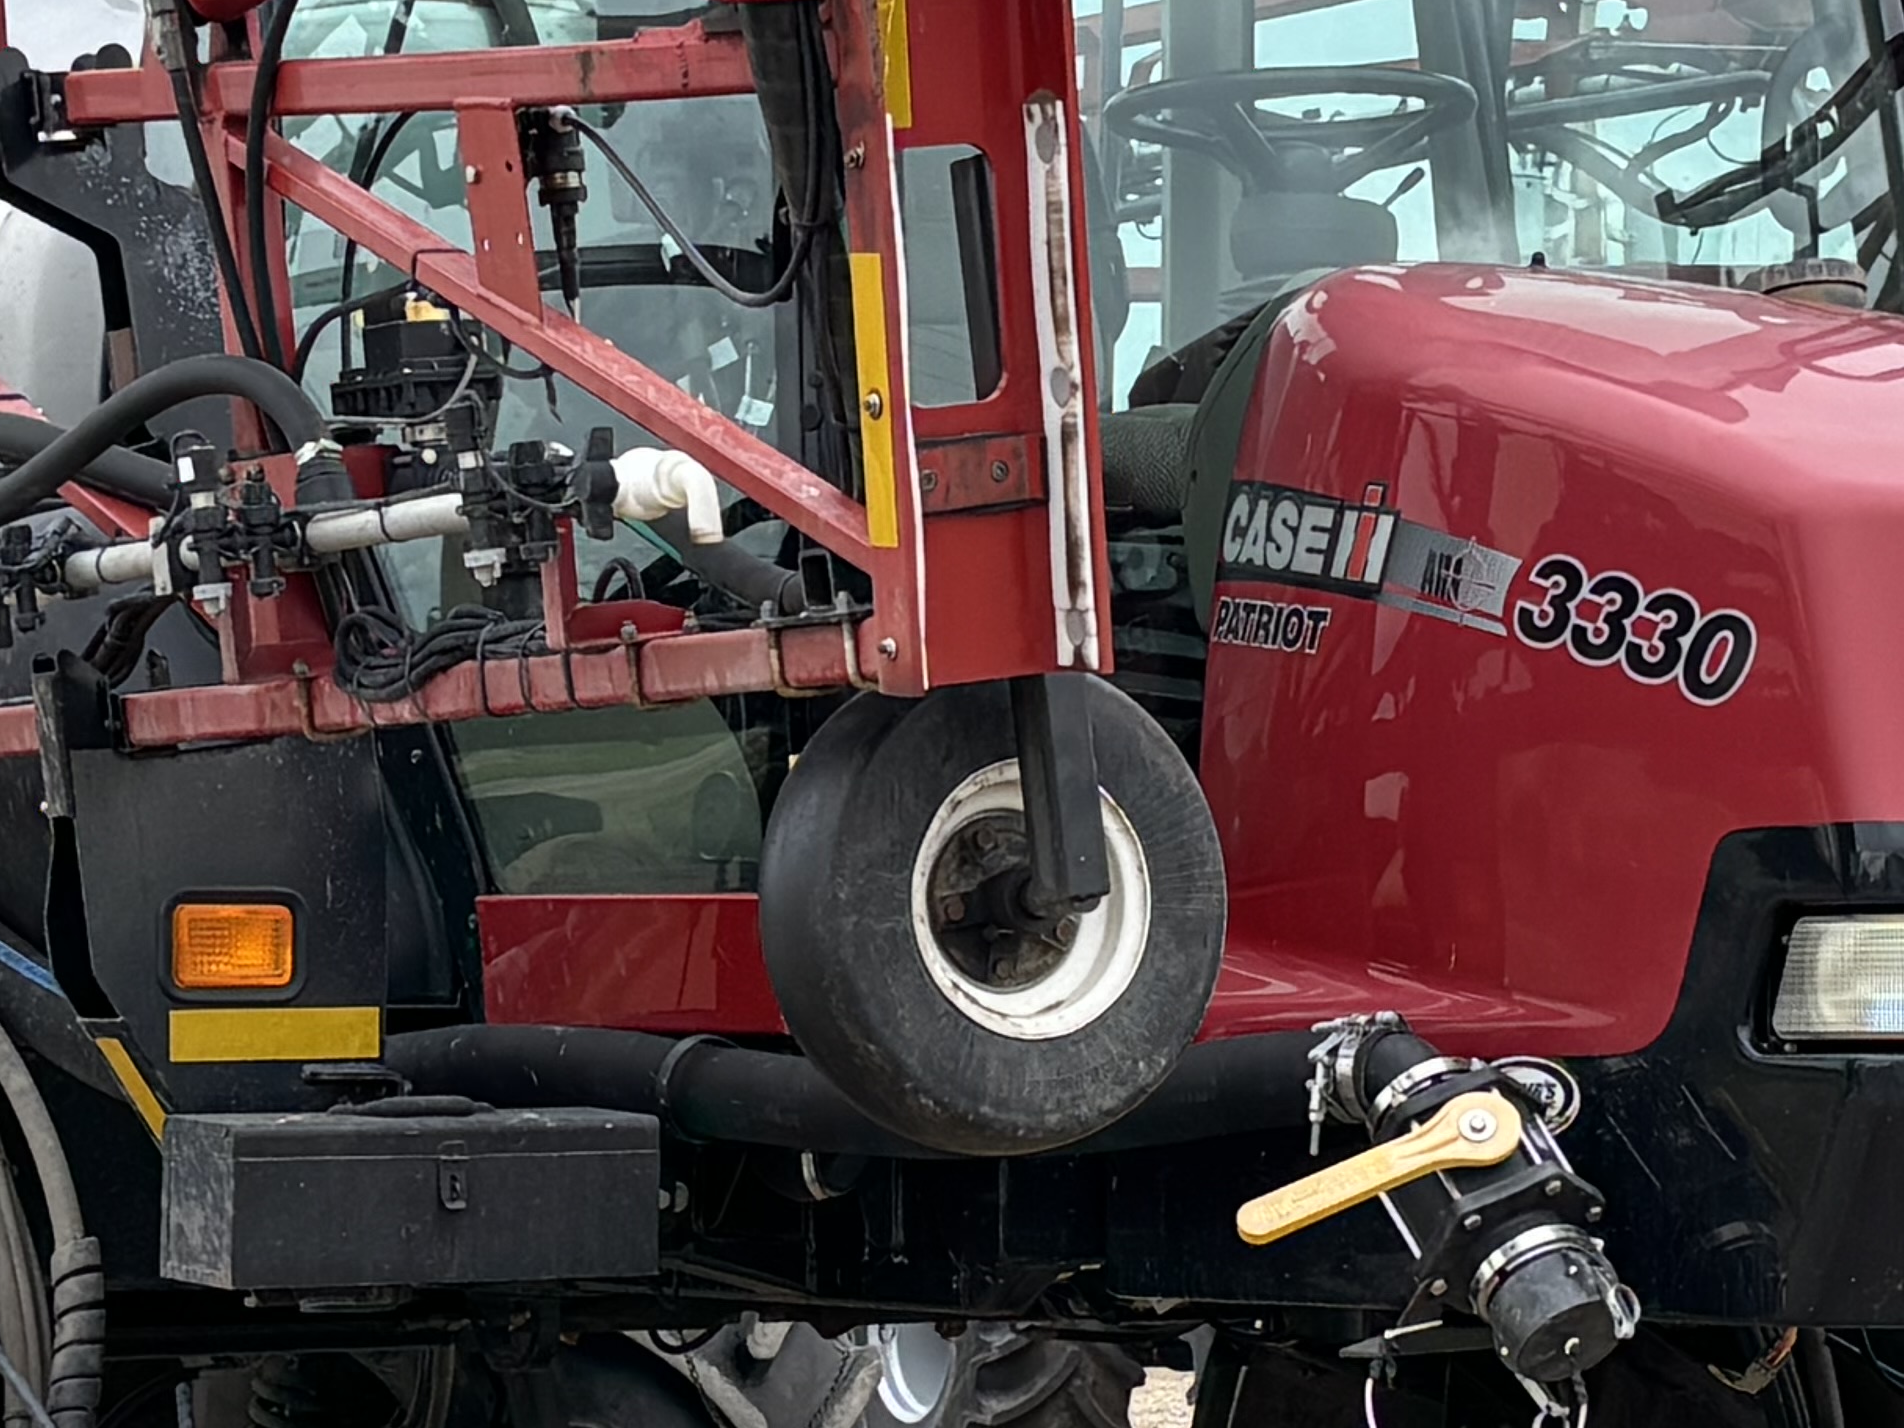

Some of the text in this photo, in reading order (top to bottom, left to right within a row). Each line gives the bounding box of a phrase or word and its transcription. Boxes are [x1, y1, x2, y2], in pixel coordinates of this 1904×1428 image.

[1223, 493, 1335, 575] CASE
[1210, 596, 1332, 655] PATRIOT
[1514, 554, 1757, 707] 3330
